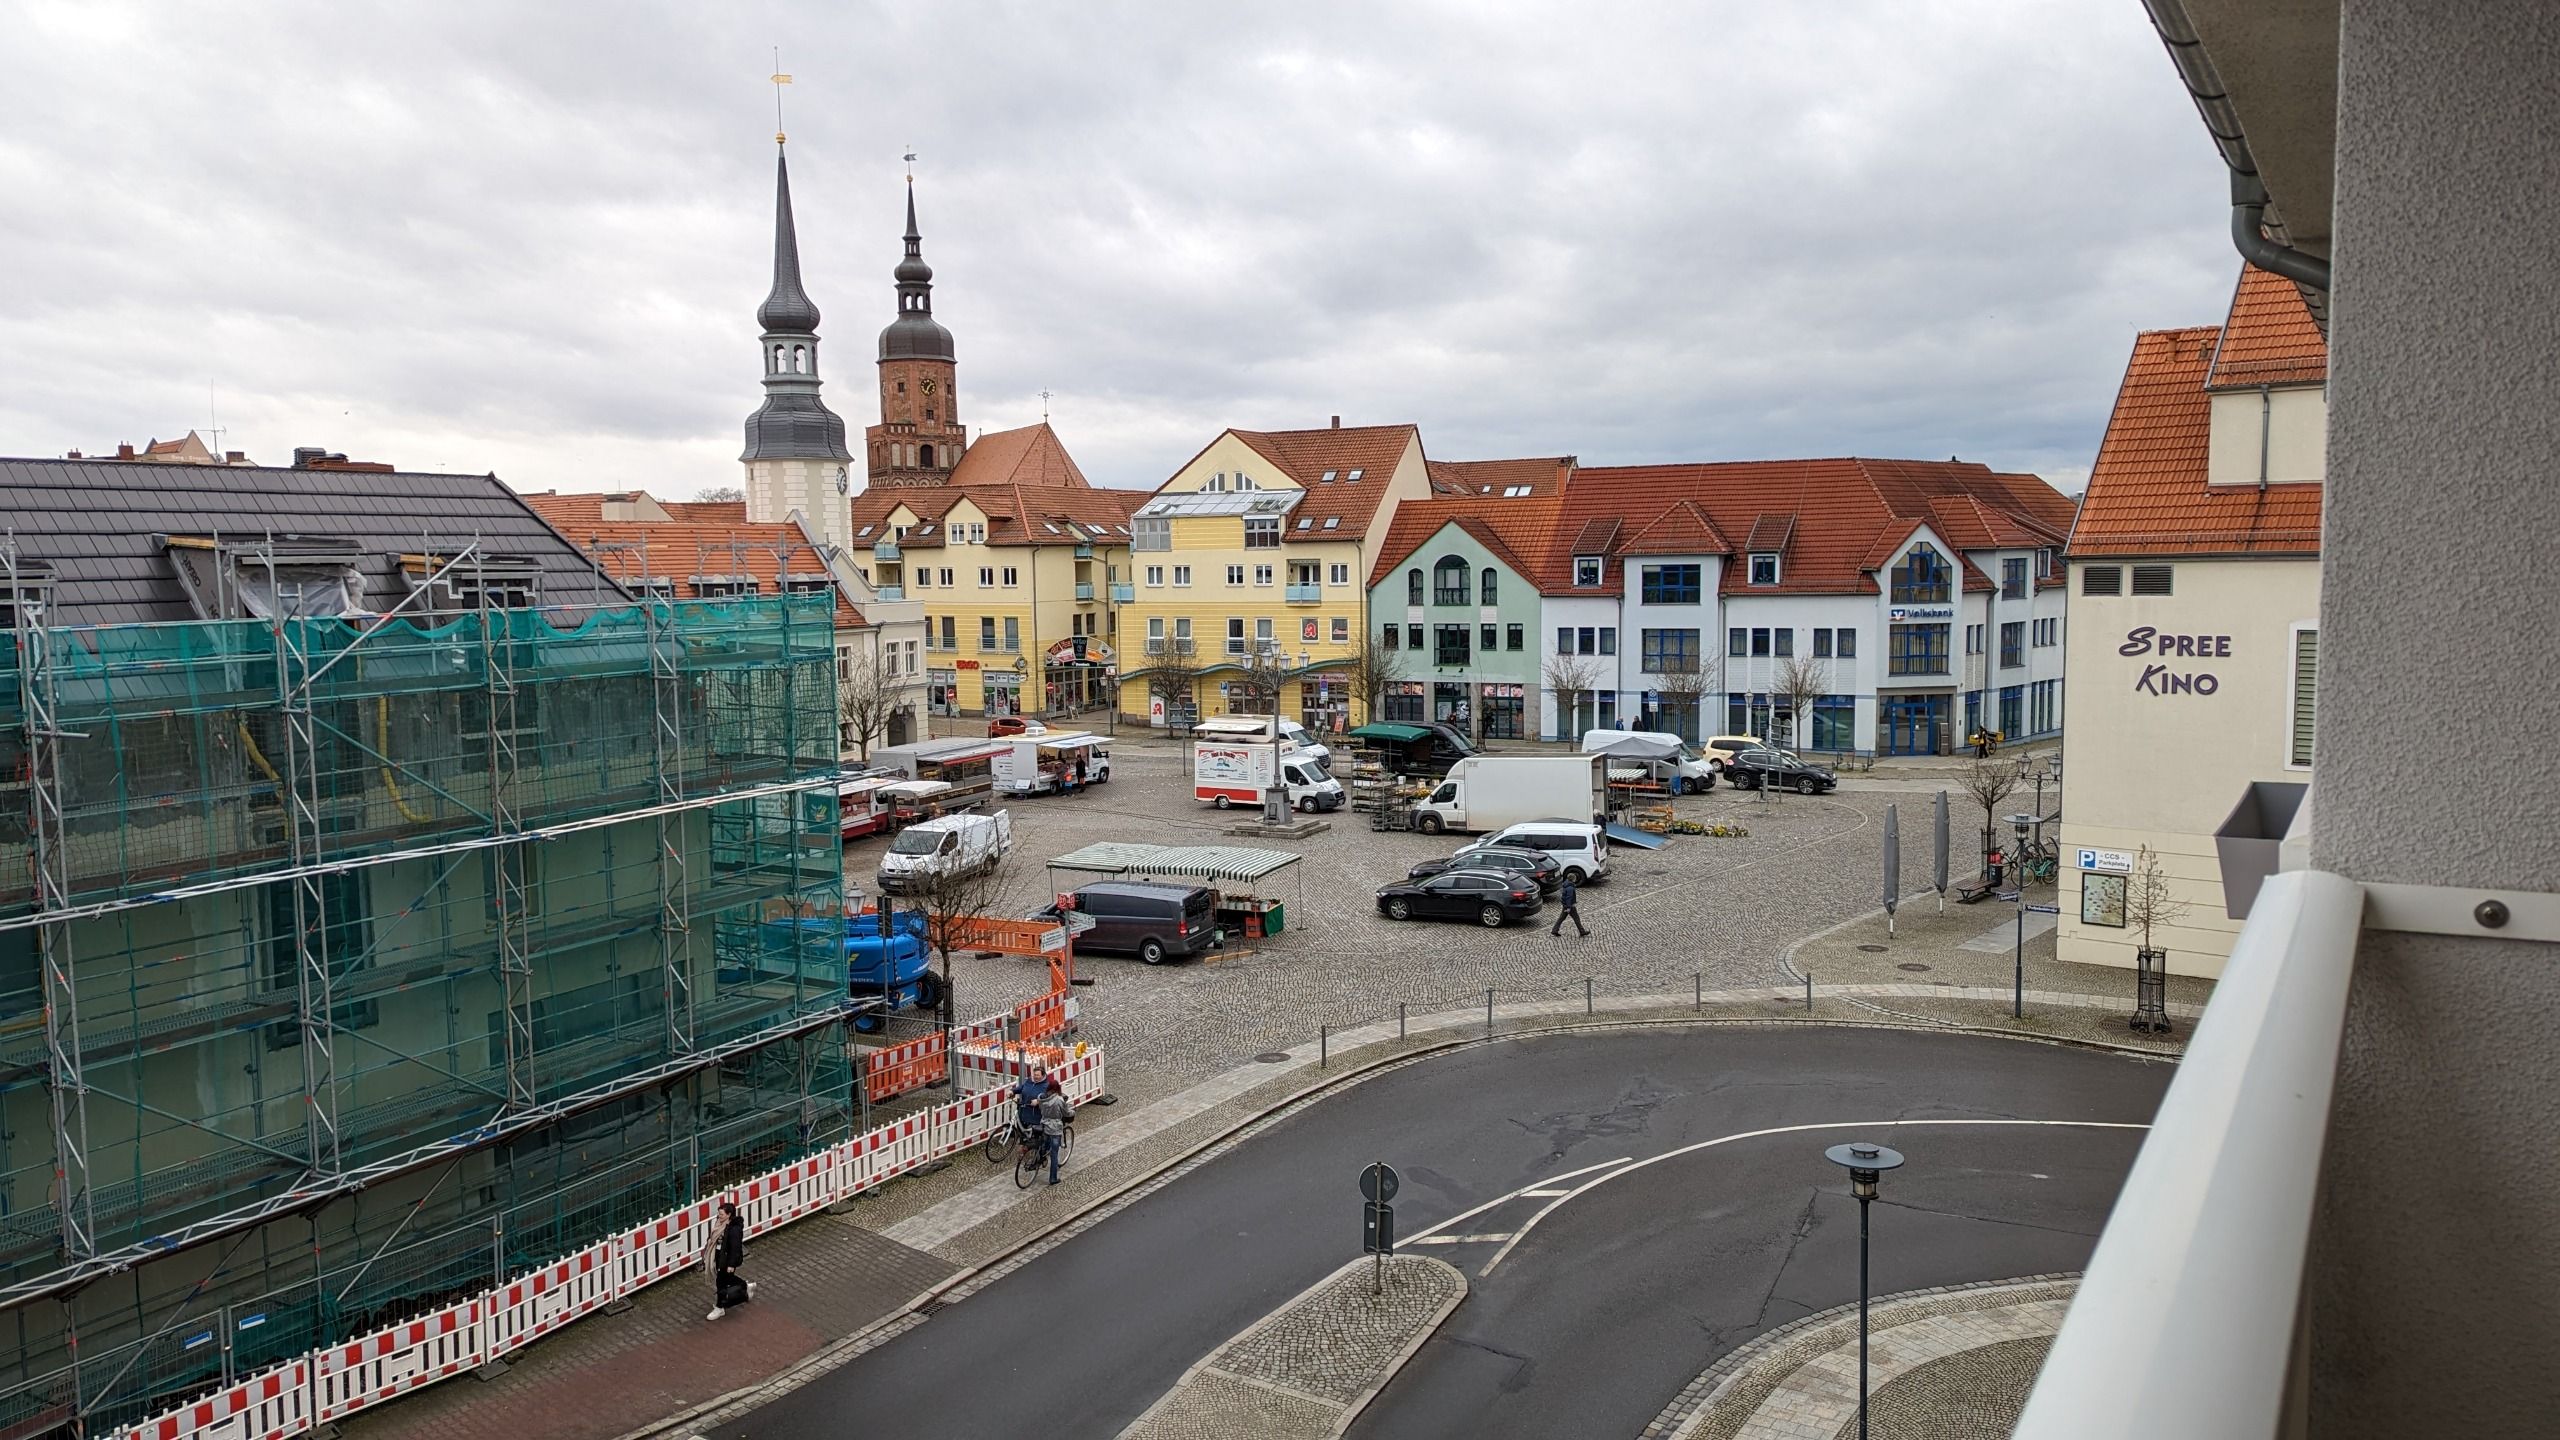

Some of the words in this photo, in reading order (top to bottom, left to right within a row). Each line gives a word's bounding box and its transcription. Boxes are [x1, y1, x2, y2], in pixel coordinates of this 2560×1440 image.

[1907, 608, 1954, 617] Volksbank
[2118, 626, 2232, 657] SPREE
[2135, 664, 2219, 697] KINO
[2080, 851, 2094, 866] P
